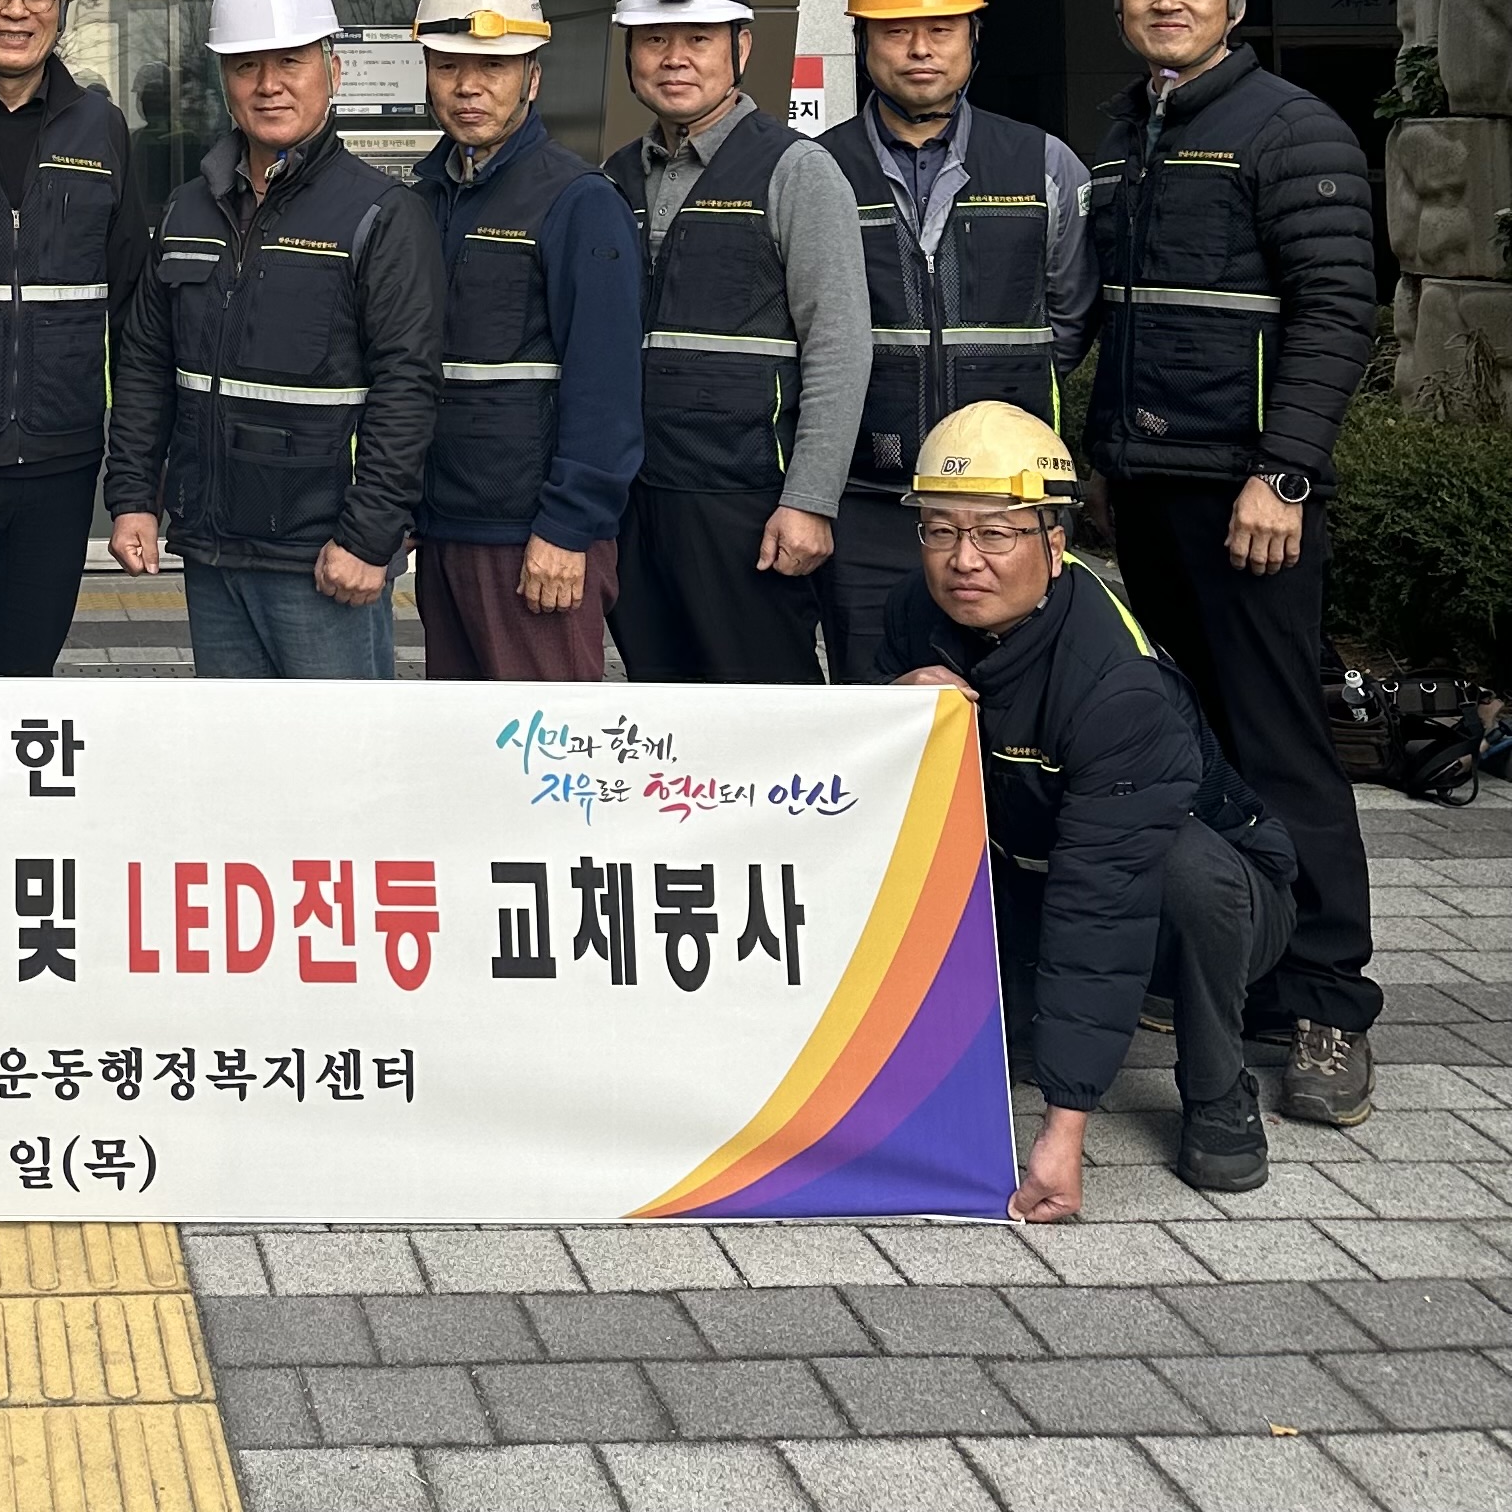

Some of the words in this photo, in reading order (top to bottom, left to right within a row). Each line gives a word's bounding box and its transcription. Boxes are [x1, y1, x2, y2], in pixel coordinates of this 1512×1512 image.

[941, 456, 971, 475] DY
[496, 709, 602, 775] 시민과
[530, 773, 632, 826] 자유로운
[643, 773, 756, 824] 혁신도시
[768, 774, 859, 816] 안산
[15, 858, 77, 983] 및
[128, 859, 441, 992] LED전등
[491, 855, 806, 993] 교체봉사
